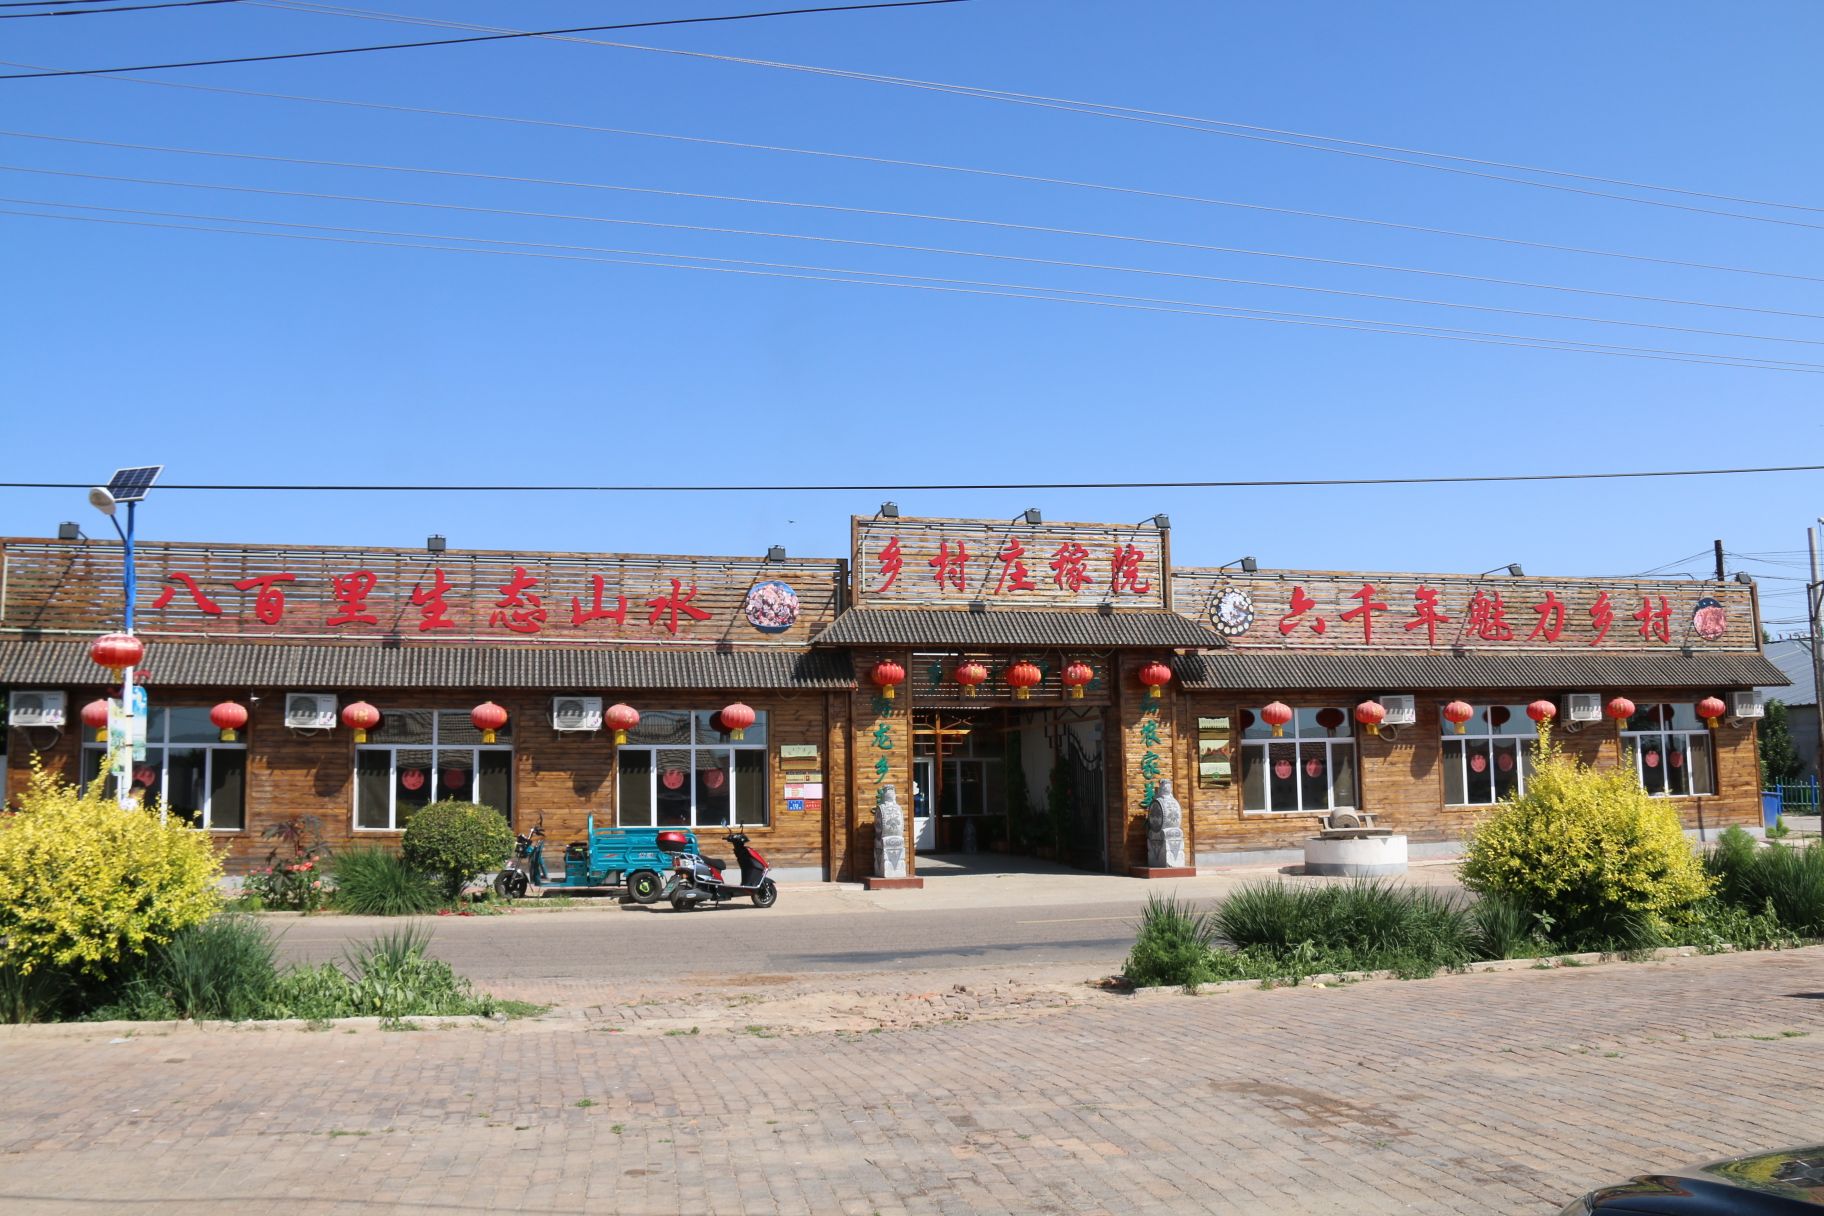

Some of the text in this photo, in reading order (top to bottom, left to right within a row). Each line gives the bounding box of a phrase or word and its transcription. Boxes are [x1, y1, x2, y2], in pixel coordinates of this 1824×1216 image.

[876, 536, 1151, 594] 乡村庄稼院
[152, 567, 712, 634] 八百里生态山水
[1278, 585, 1673, 644] 六千年魅力乡村
